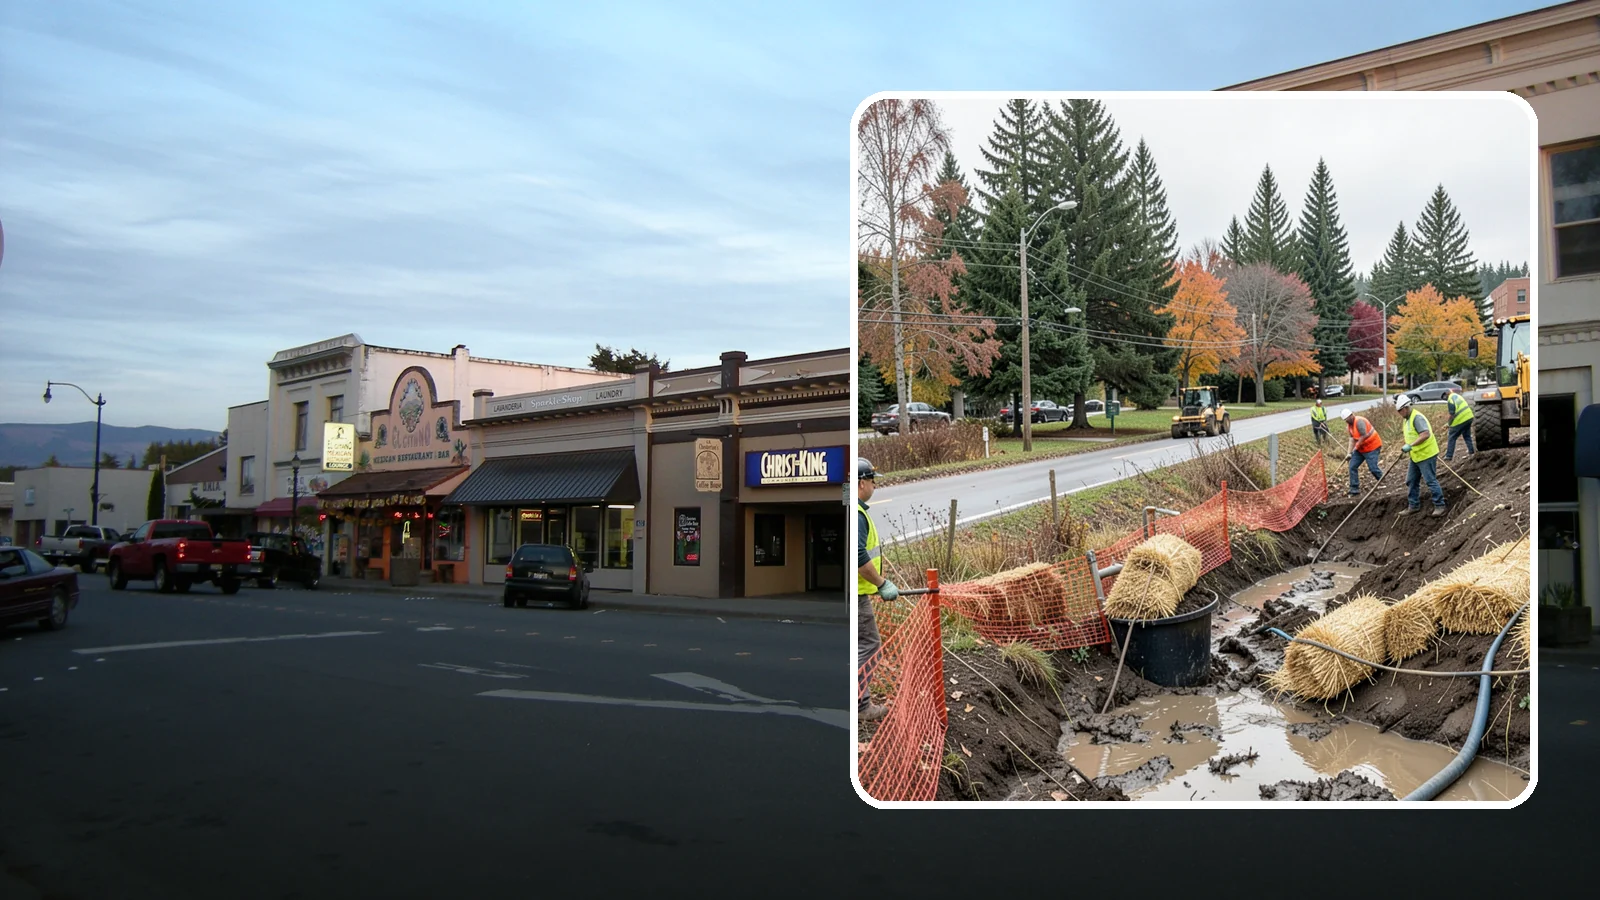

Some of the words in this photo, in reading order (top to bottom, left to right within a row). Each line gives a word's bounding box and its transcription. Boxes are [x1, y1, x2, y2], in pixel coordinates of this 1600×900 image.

[530, 397, 559, 409] Sparkle
[562, 394, 583, 405] Shop
[595, 389, 624, 400] LAUNDRY
[493, 402, 523, 413] LAVANDERIA
[373, 455, 396, 464] MEXICAN
[397, 452, 433, 462] RESTAURANT
[437, 450, 450, 459] BAR
[761, 452, 797, 478] CHRIST
[798, 450, 827, 477] KING
